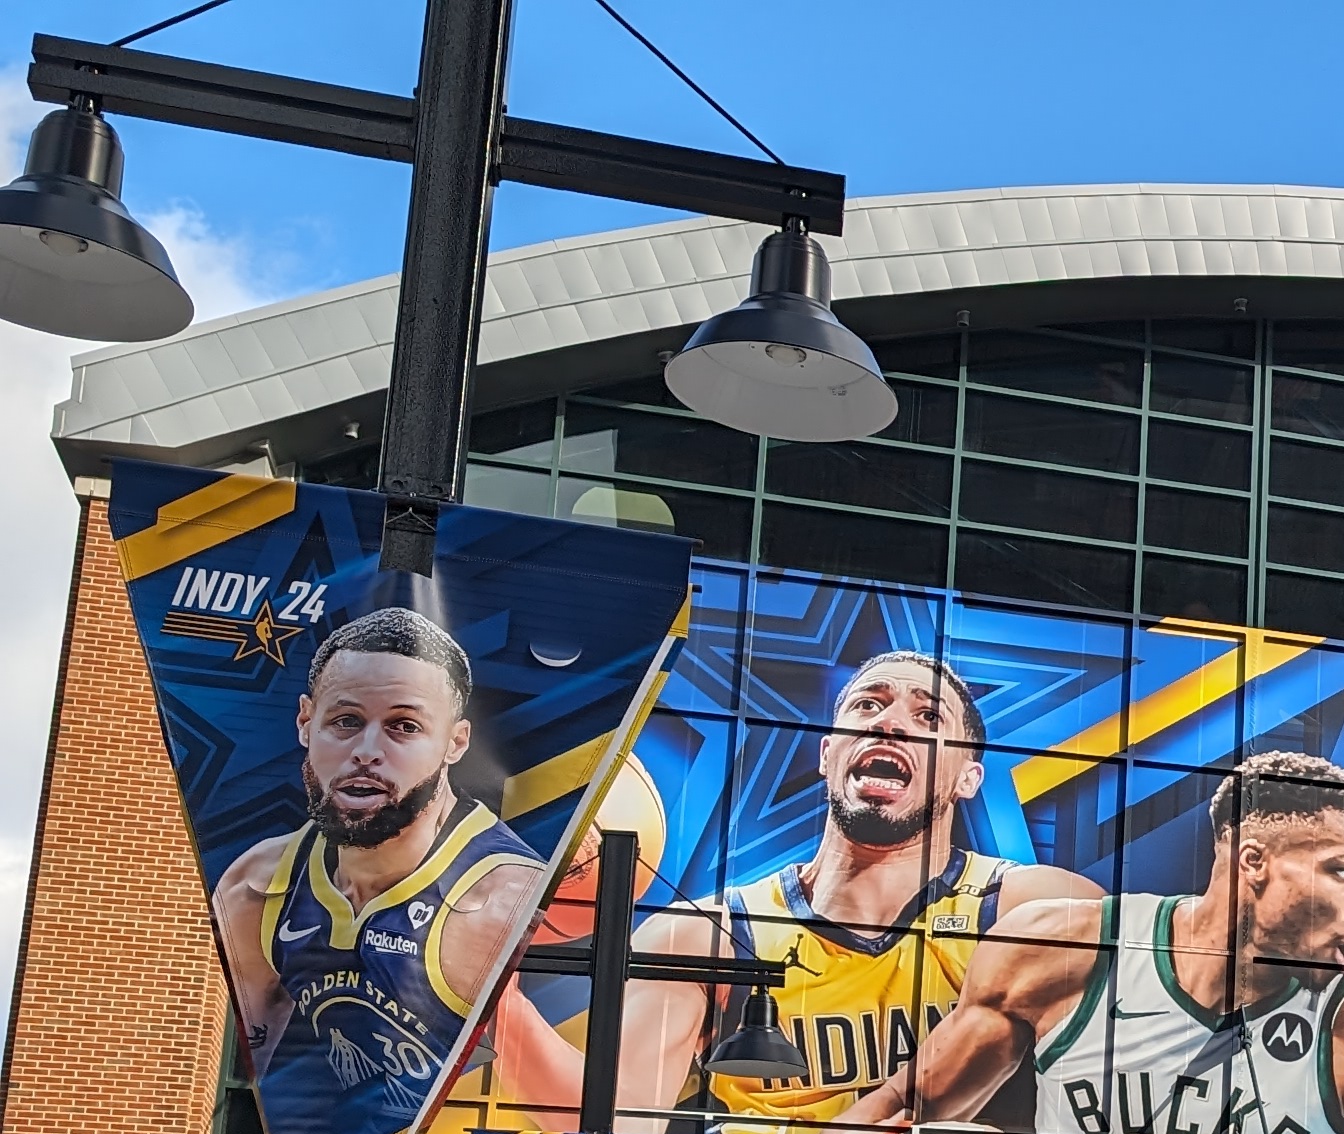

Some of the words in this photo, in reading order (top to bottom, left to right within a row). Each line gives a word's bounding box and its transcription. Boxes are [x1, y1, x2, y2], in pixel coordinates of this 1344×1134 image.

[171, 566, 270, 615] INDY
[278, 581, 330, 624] 24
[365, 929, 418, 956] Rakuten
[298, 970, 360, 1017] GOLDEN
[365, 980, 429, 1036] STATE
[372, 1031, 432, 1080] 30
